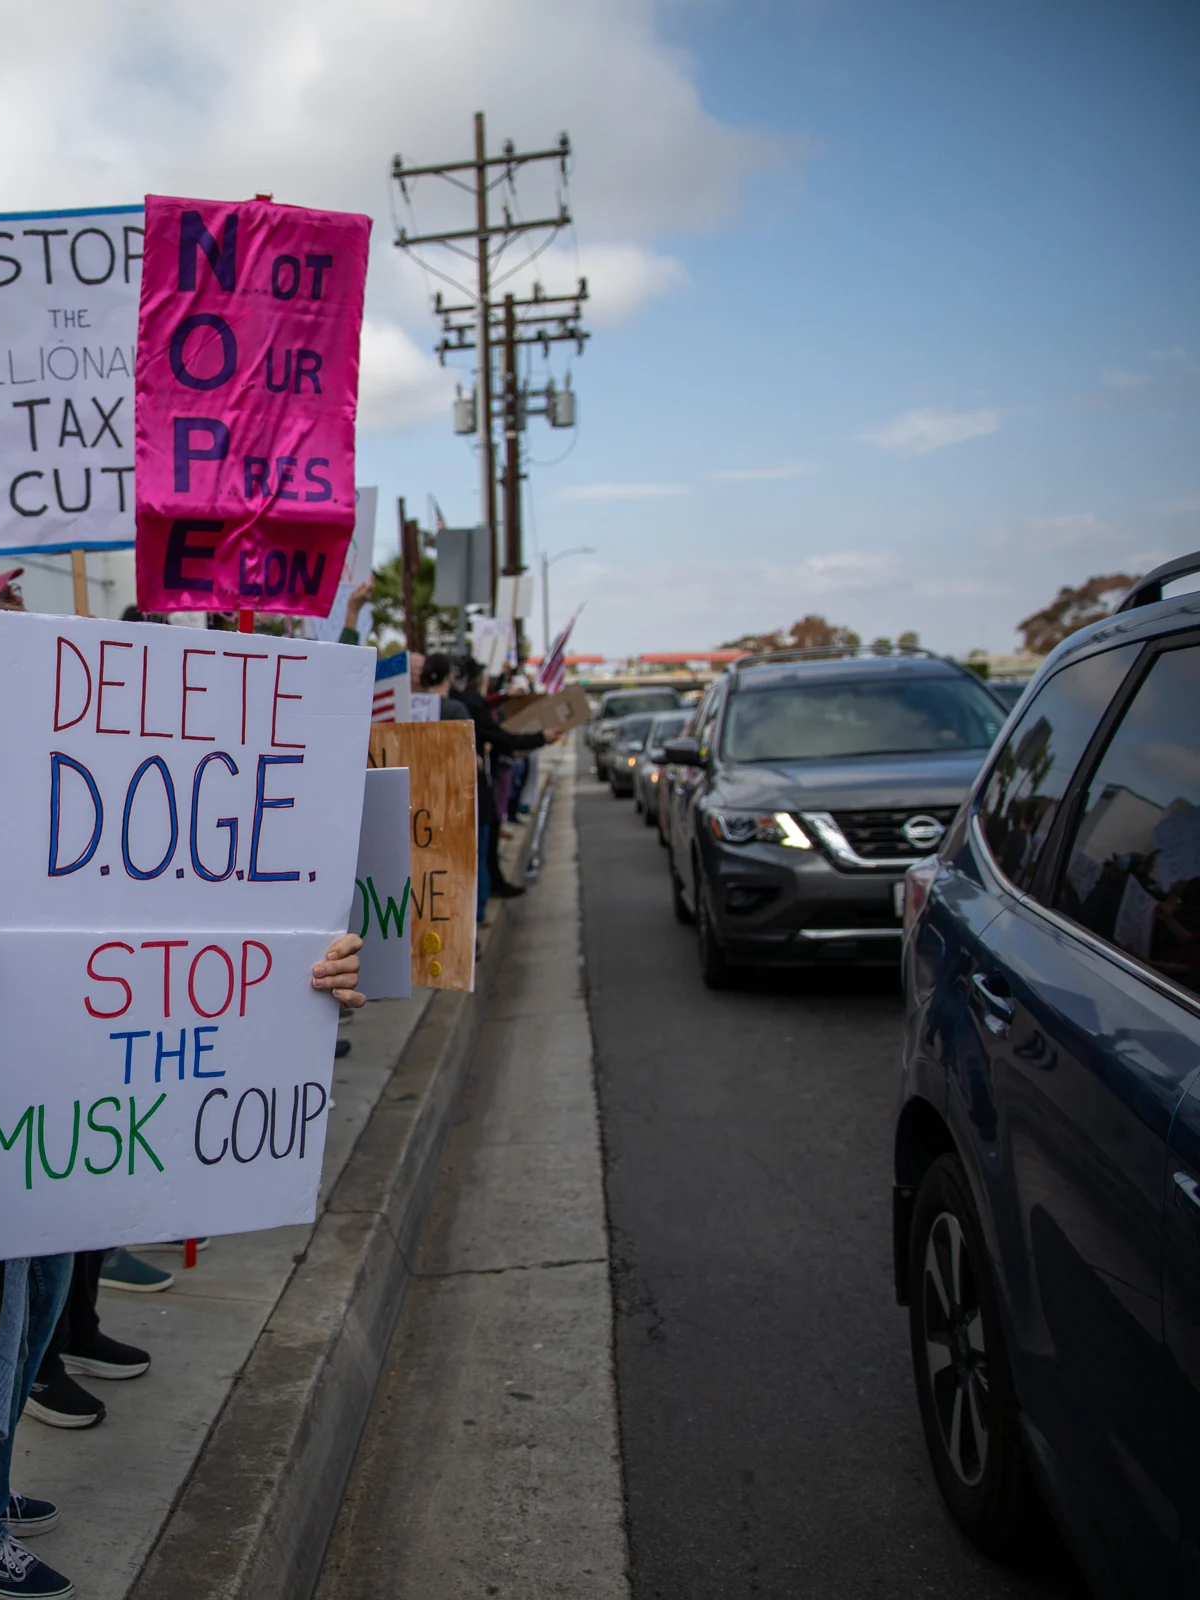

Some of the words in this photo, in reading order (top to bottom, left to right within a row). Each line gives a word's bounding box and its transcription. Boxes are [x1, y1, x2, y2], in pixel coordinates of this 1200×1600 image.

[47, 309, 92, 329] THE
[12, 397, 124, 451] TAX
[9, 466, 135, 517] CUT
[54, 636, 307, 748] DELETE
[48, 751, 316, 882] D.O.G.E.
[84, 941, 272, 1019] STOP
[109, 1026, 226, 1084] THE
[194, 1081, 326, 1165] COUP
